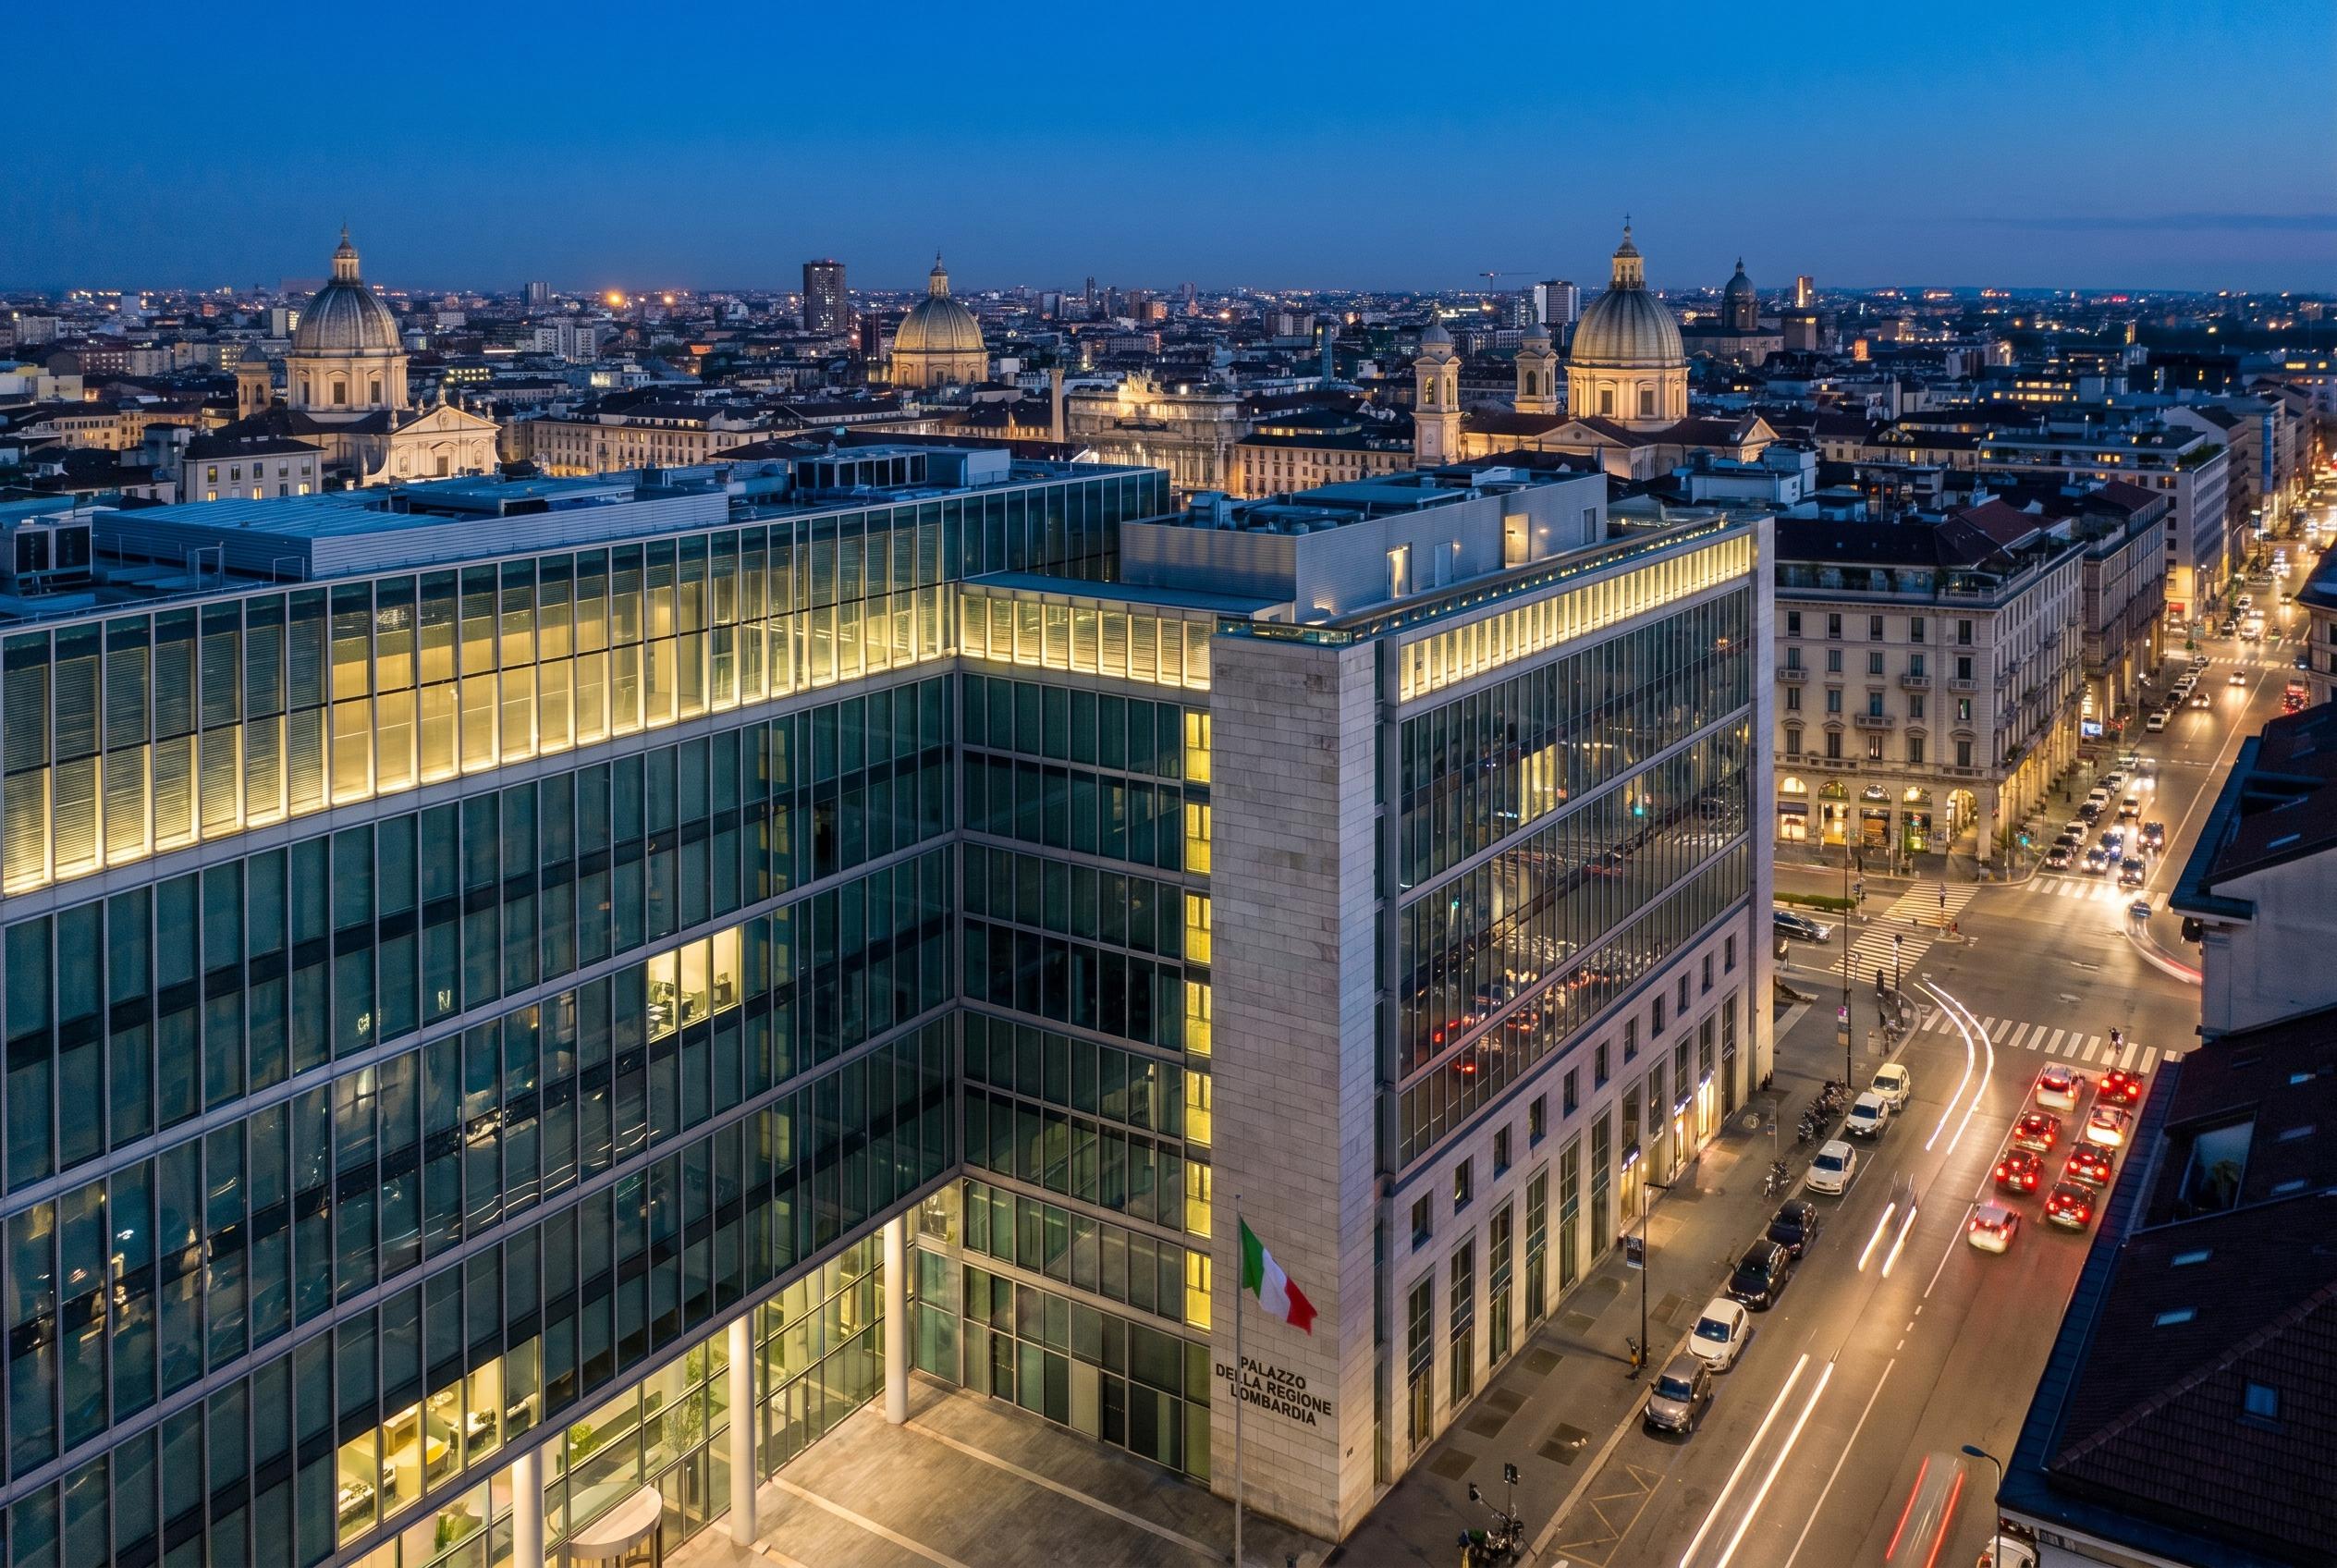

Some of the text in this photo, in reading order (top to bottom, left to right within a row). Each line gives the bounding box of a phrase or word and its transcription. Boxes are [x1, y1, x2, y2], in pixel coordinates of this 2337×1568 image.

[1216, 1363, 1332, 1416] DELLA REGIONE
[1242, 1355, 1306, 1390] PALAZZO
[1230, 1383, 1316, 1427] LOMBARDIA
